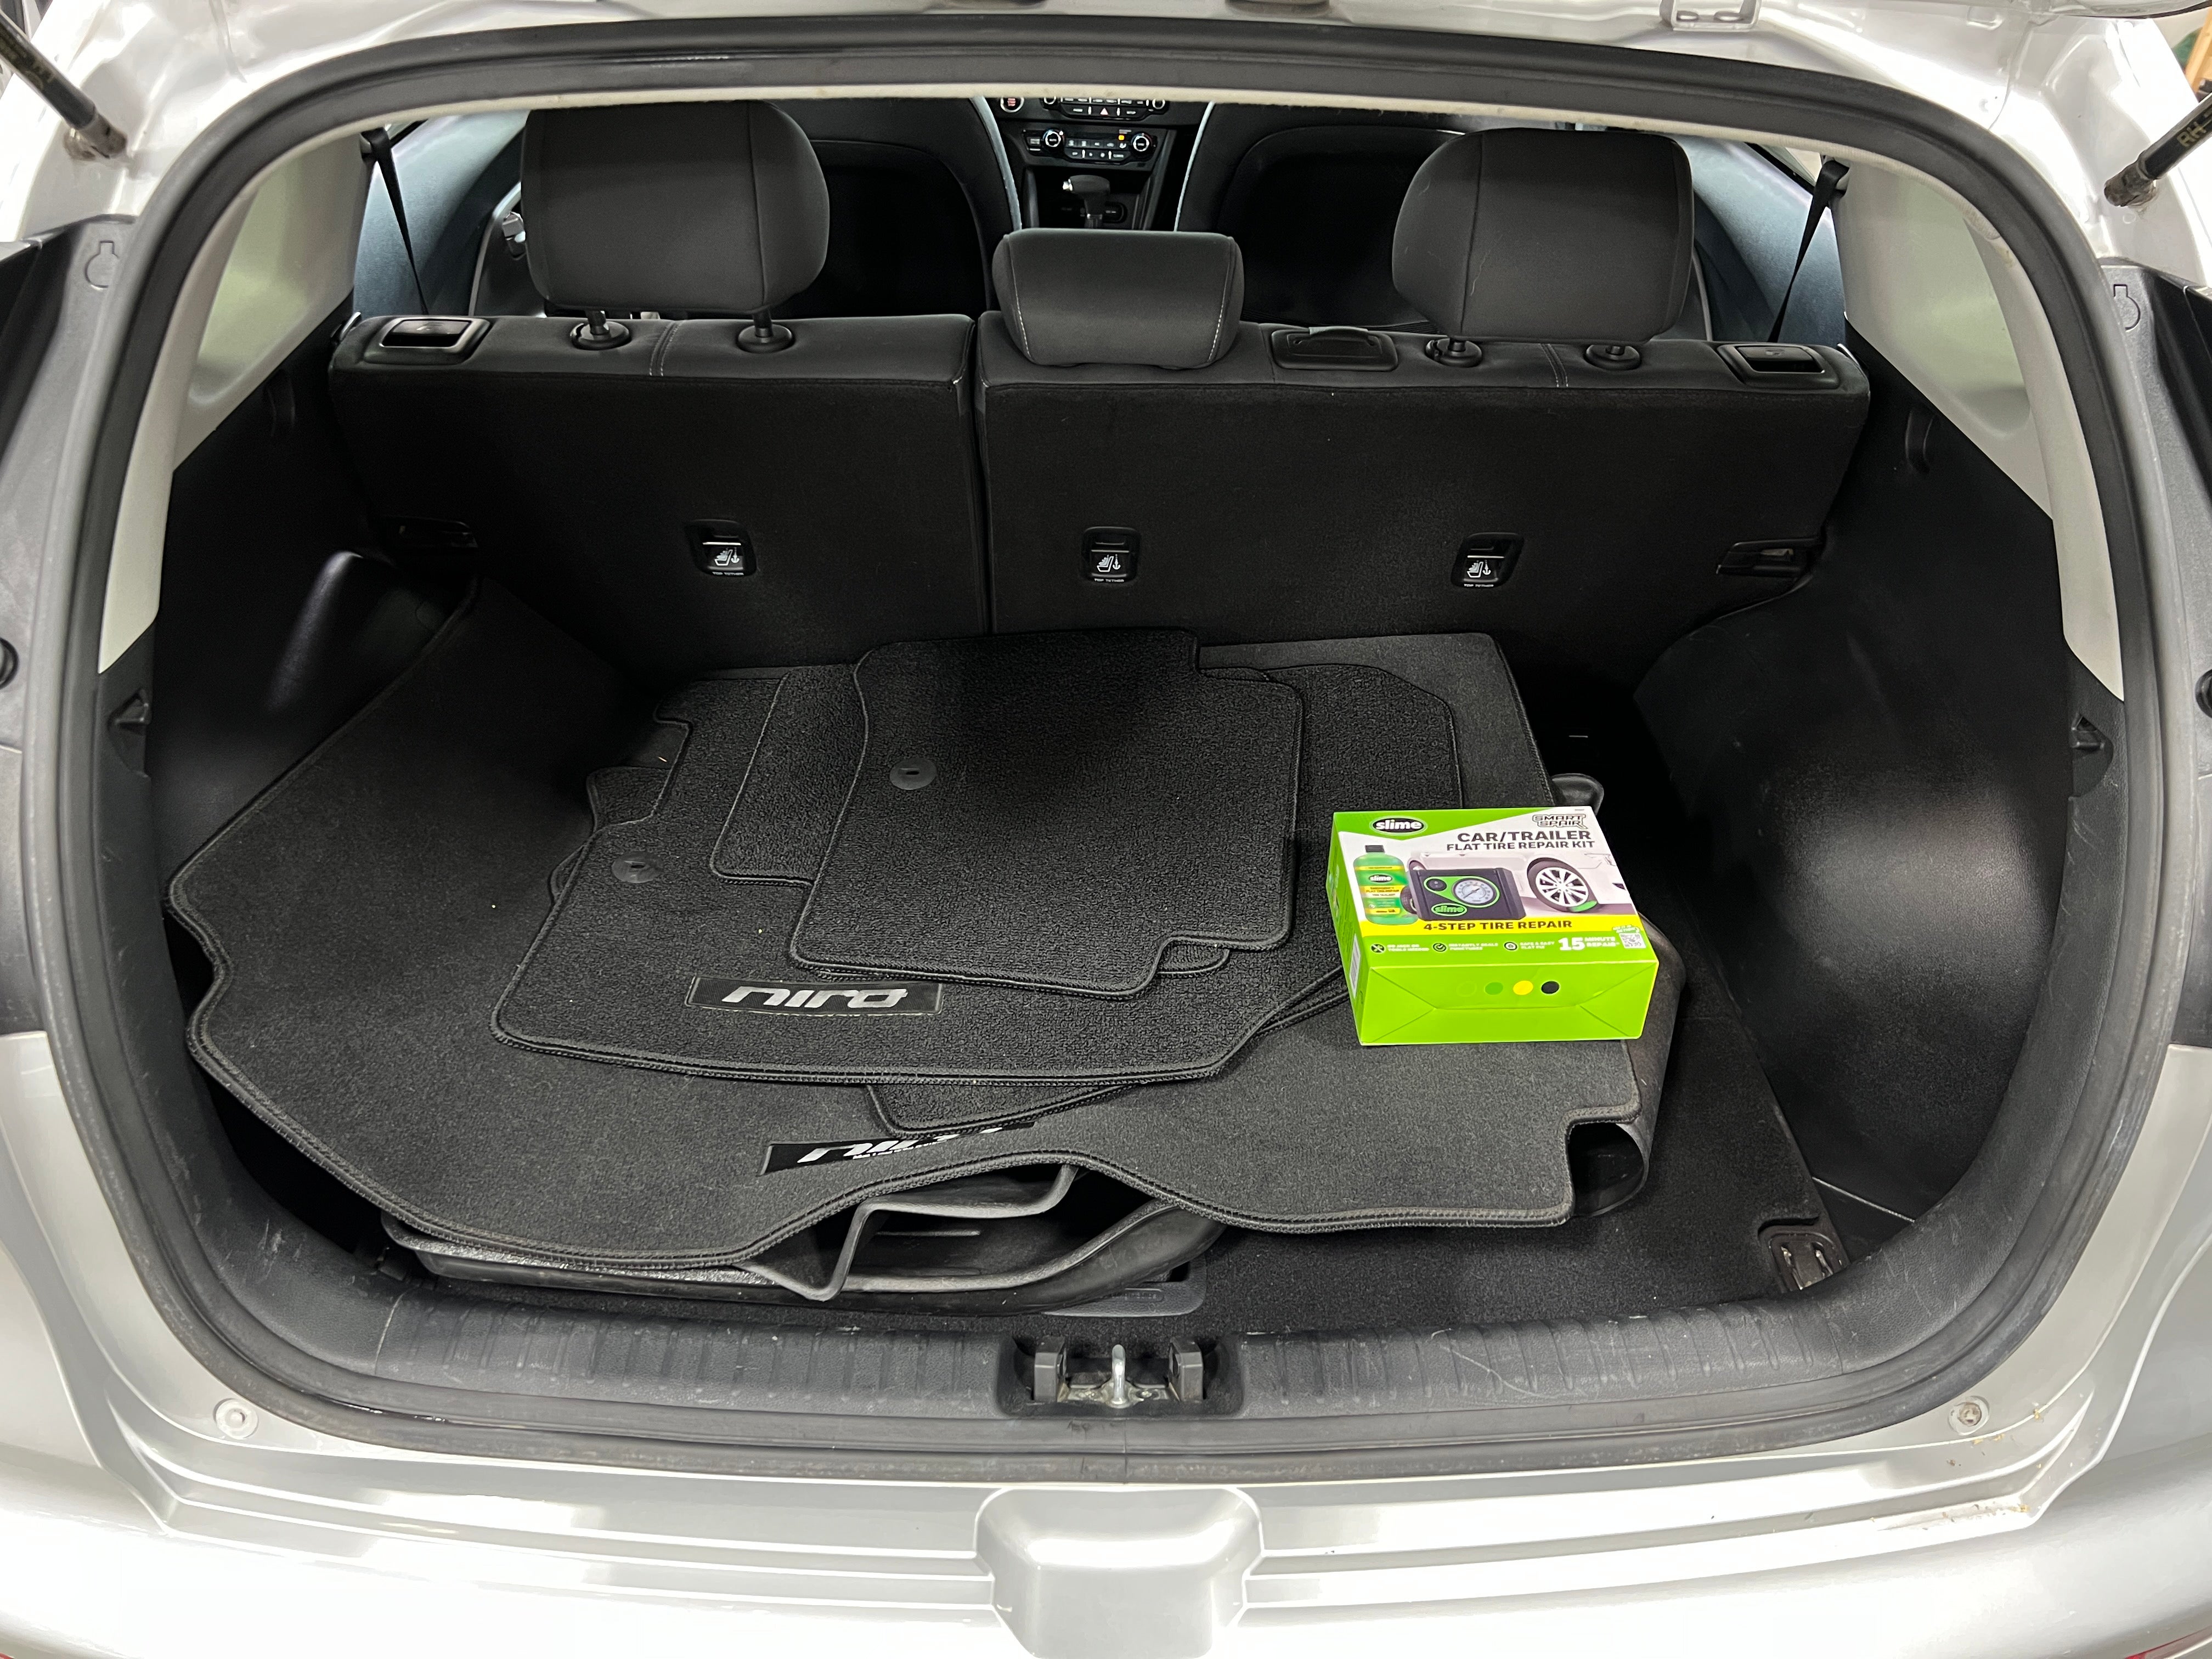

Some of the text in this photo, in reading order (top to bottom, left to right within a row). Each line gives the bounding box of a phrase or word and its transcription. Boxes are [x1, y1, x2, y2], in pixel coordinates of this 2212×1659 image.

[1375, 820, 1422, 830] slime
[1457, 831, 1592, 843] CAR/TRAILER
[1423, 920, 1572, 931] 4-STEP TIRE REPAIR
[1558, 937, 1585, 951] 15
